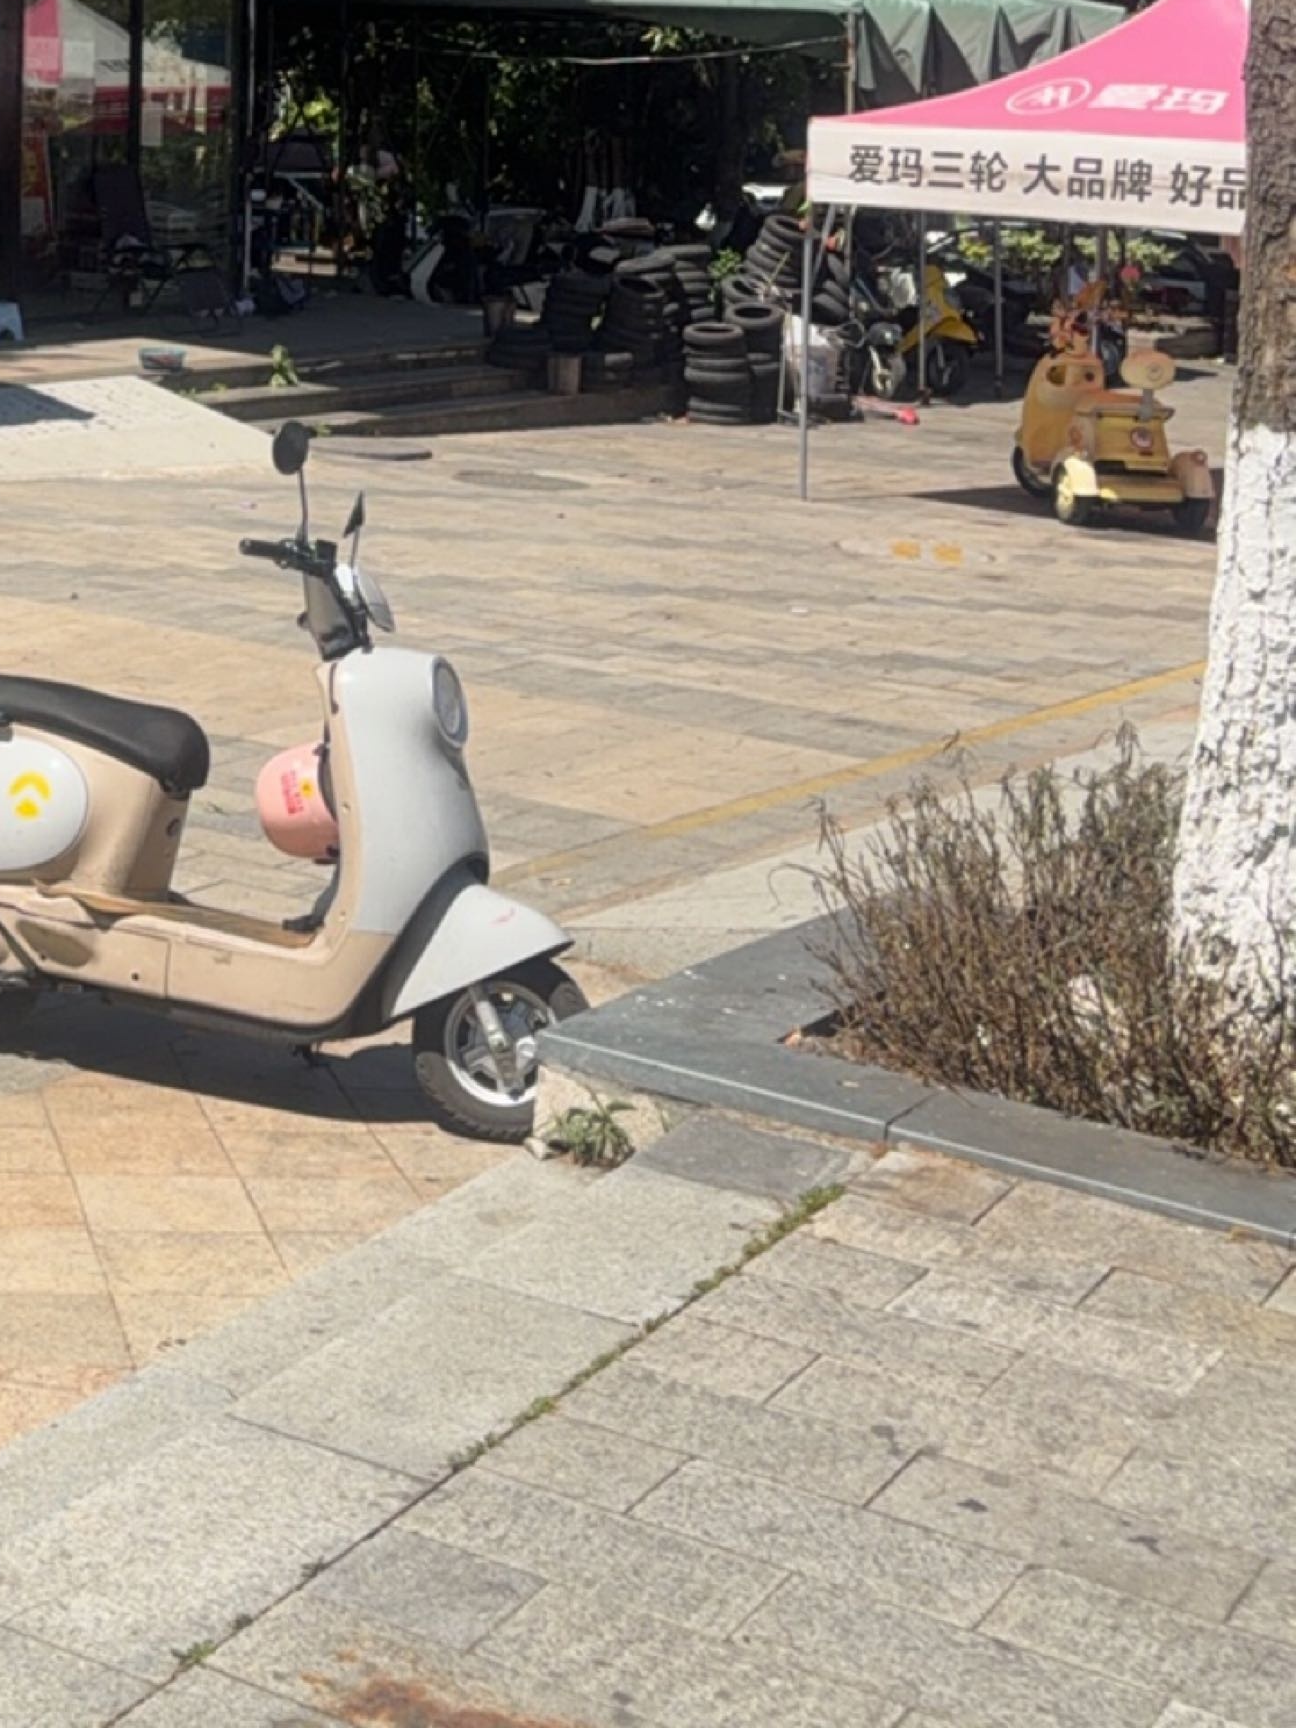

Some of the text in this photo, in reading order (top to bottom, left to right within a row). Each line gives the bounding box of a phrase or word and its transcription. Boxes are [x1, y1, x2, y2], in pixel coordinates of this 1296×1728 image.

[1088, 83, 1231, 115] 爱玛
[848, 144, 1247, 210] 爱玛三轮 大品牌 好品
